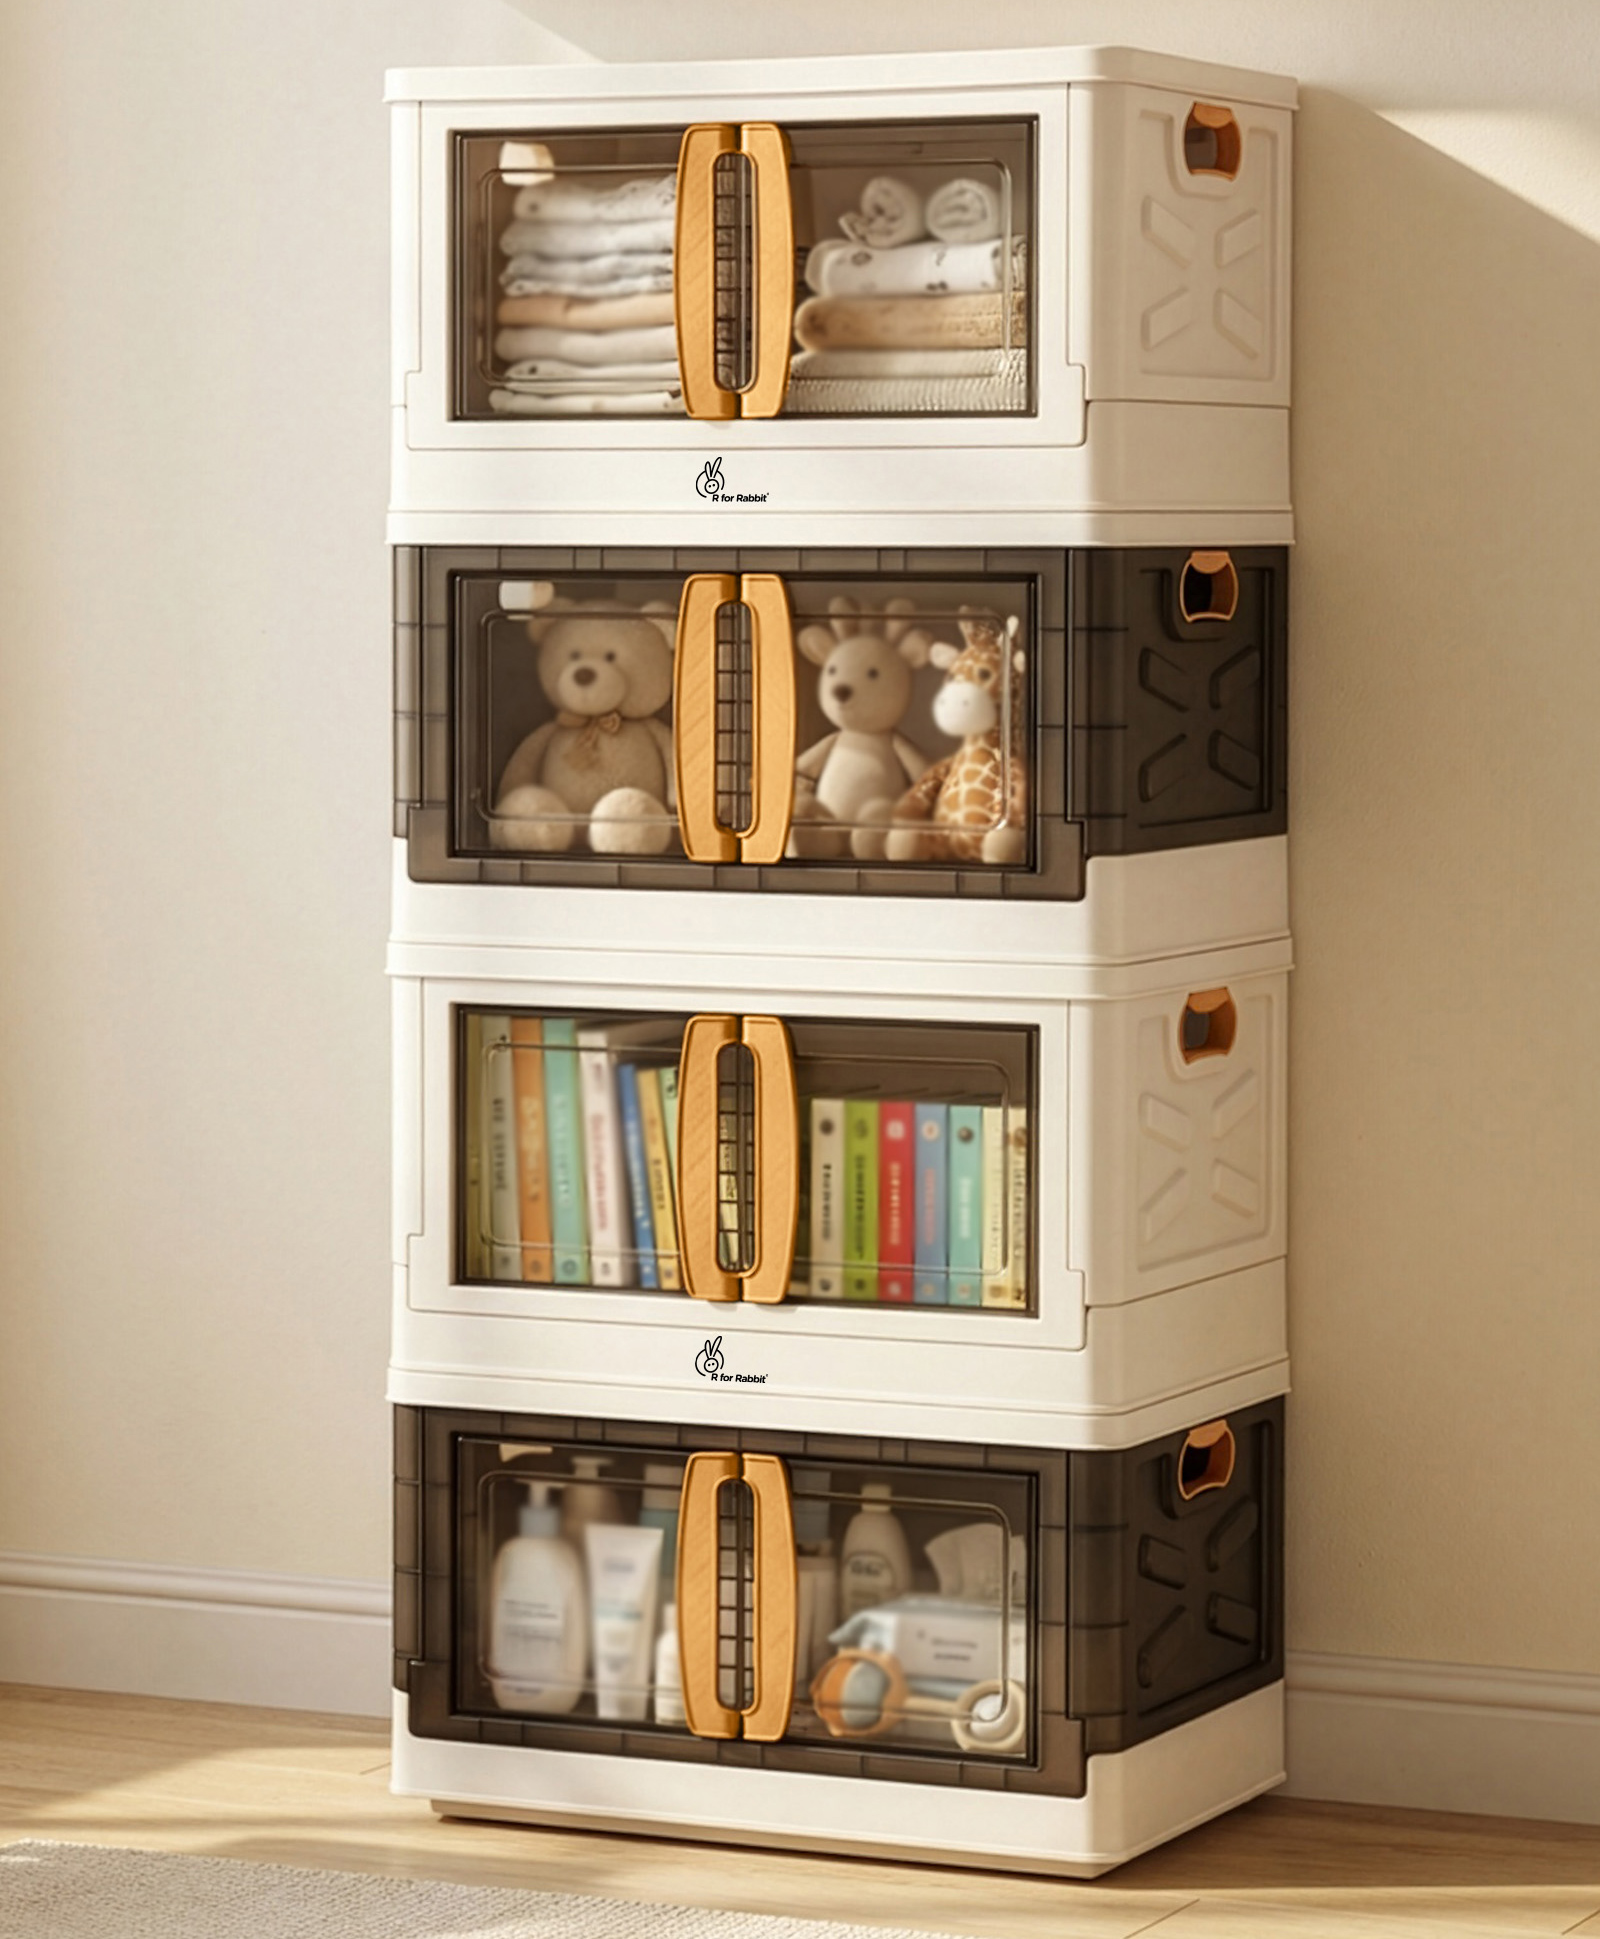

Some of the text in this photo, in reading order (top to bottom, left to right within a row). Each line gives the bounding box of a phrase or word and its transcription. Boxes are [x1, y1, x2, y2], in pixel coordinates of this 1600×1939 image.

[712, 494, 767, 502] R for Rabbit
[711, 1373, 766, 1383] R for Rabbit
